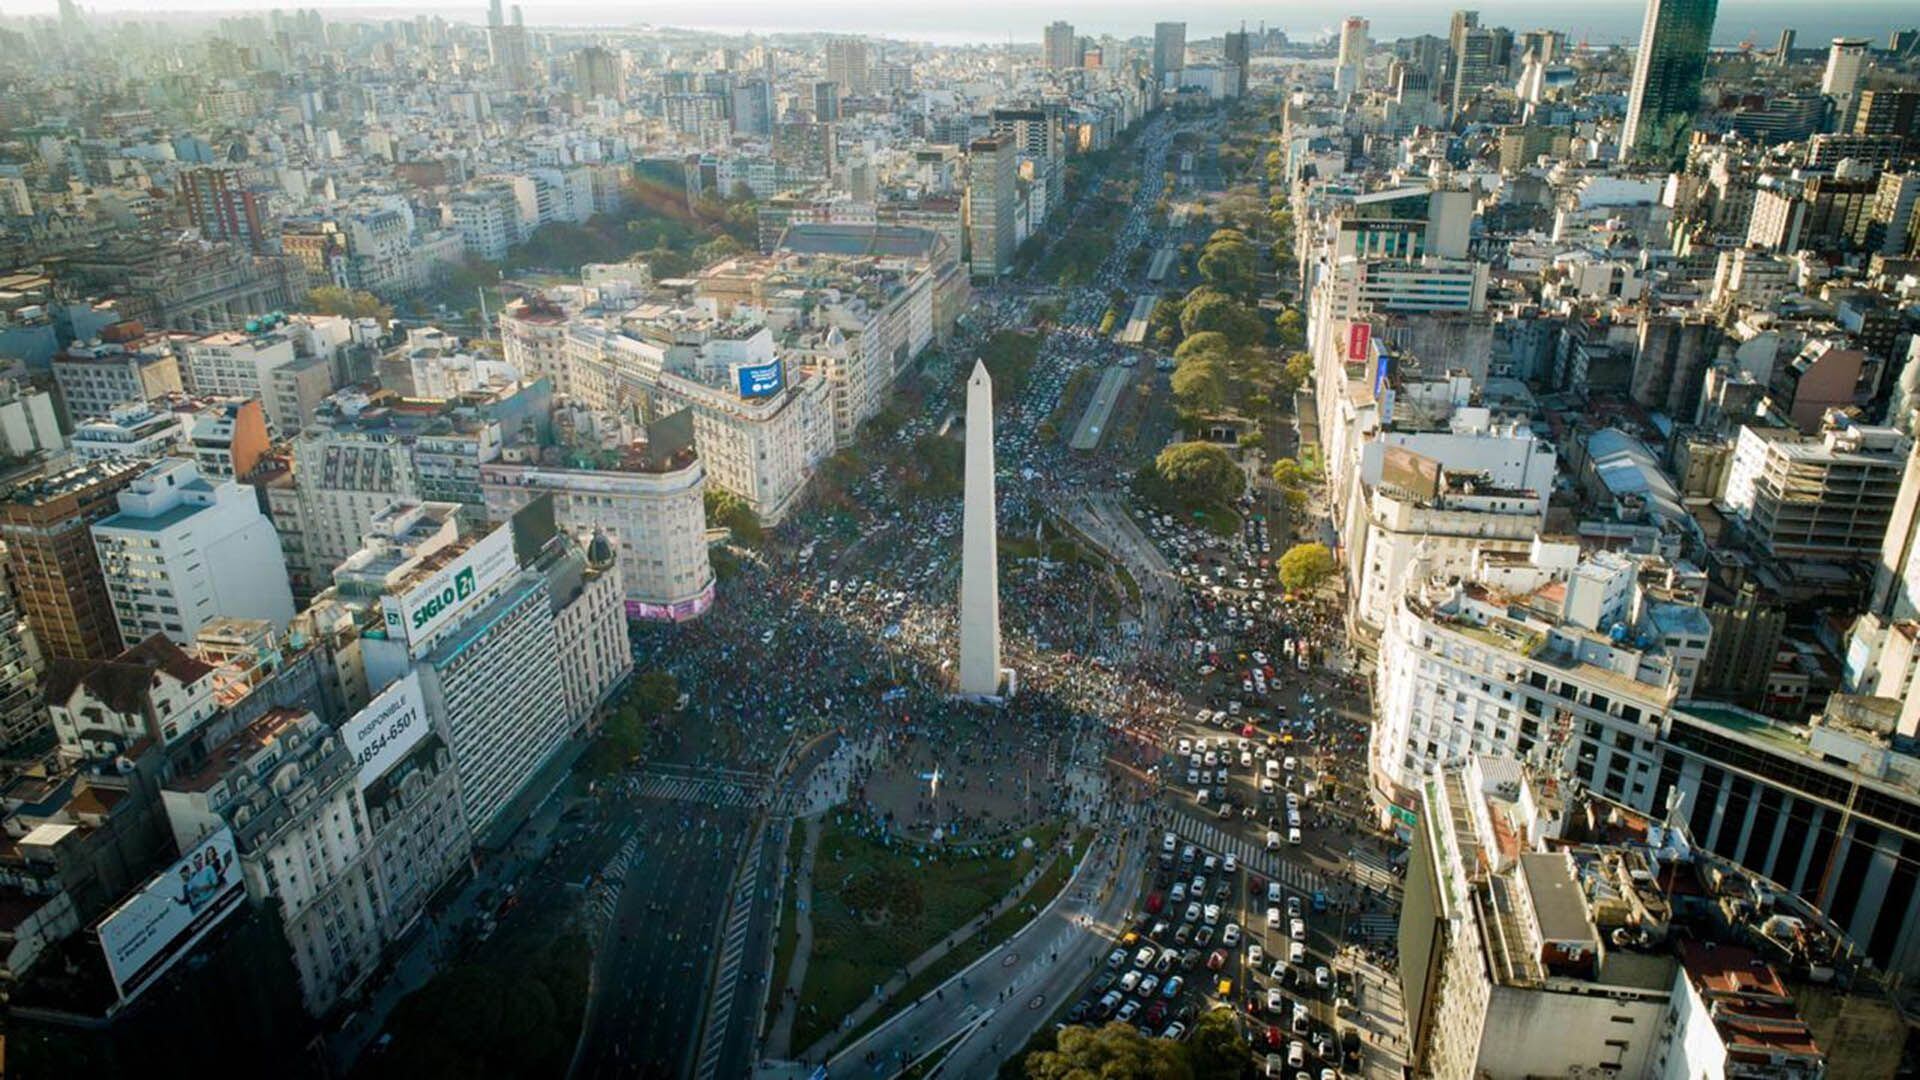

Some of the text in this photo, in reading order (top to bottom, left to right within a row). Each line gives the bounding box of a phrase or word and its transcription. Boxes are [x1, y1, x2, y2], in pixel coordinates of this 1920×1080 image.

[412, 573, 475, 629] SIGLO 21
[358, 694, 407, 740] DISPONIBLE
